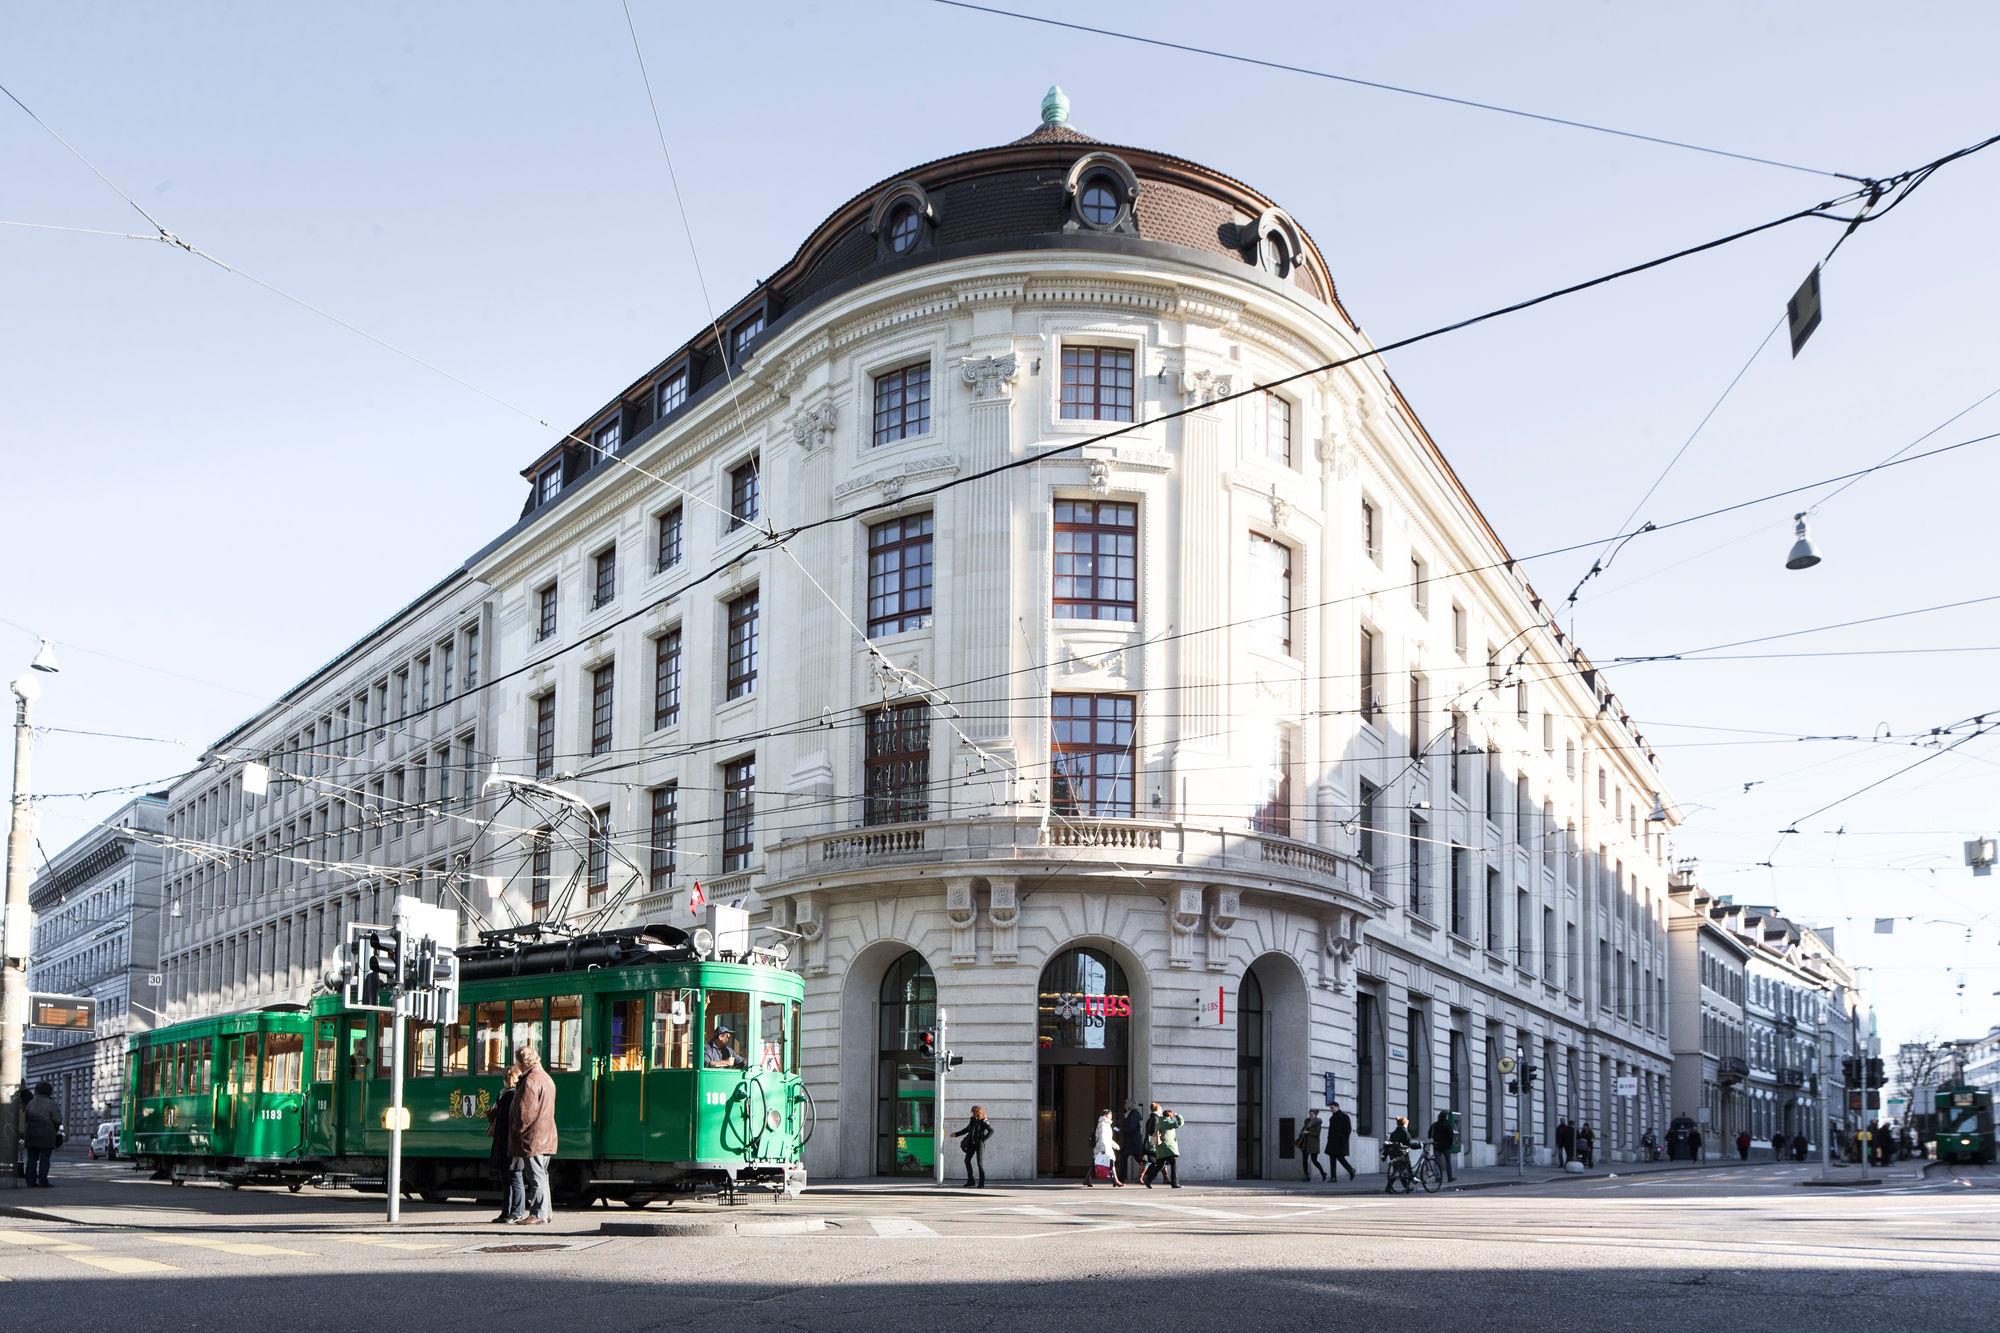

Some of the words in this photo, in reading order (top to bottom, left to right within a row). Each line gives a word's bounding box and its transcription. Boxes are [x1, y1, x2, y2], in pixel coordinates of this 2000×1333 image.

[150, 975, 161, 984] 30
[1084, 995, 1132, 1017] UBS
[261, 1109, 282, 1120] 1193
